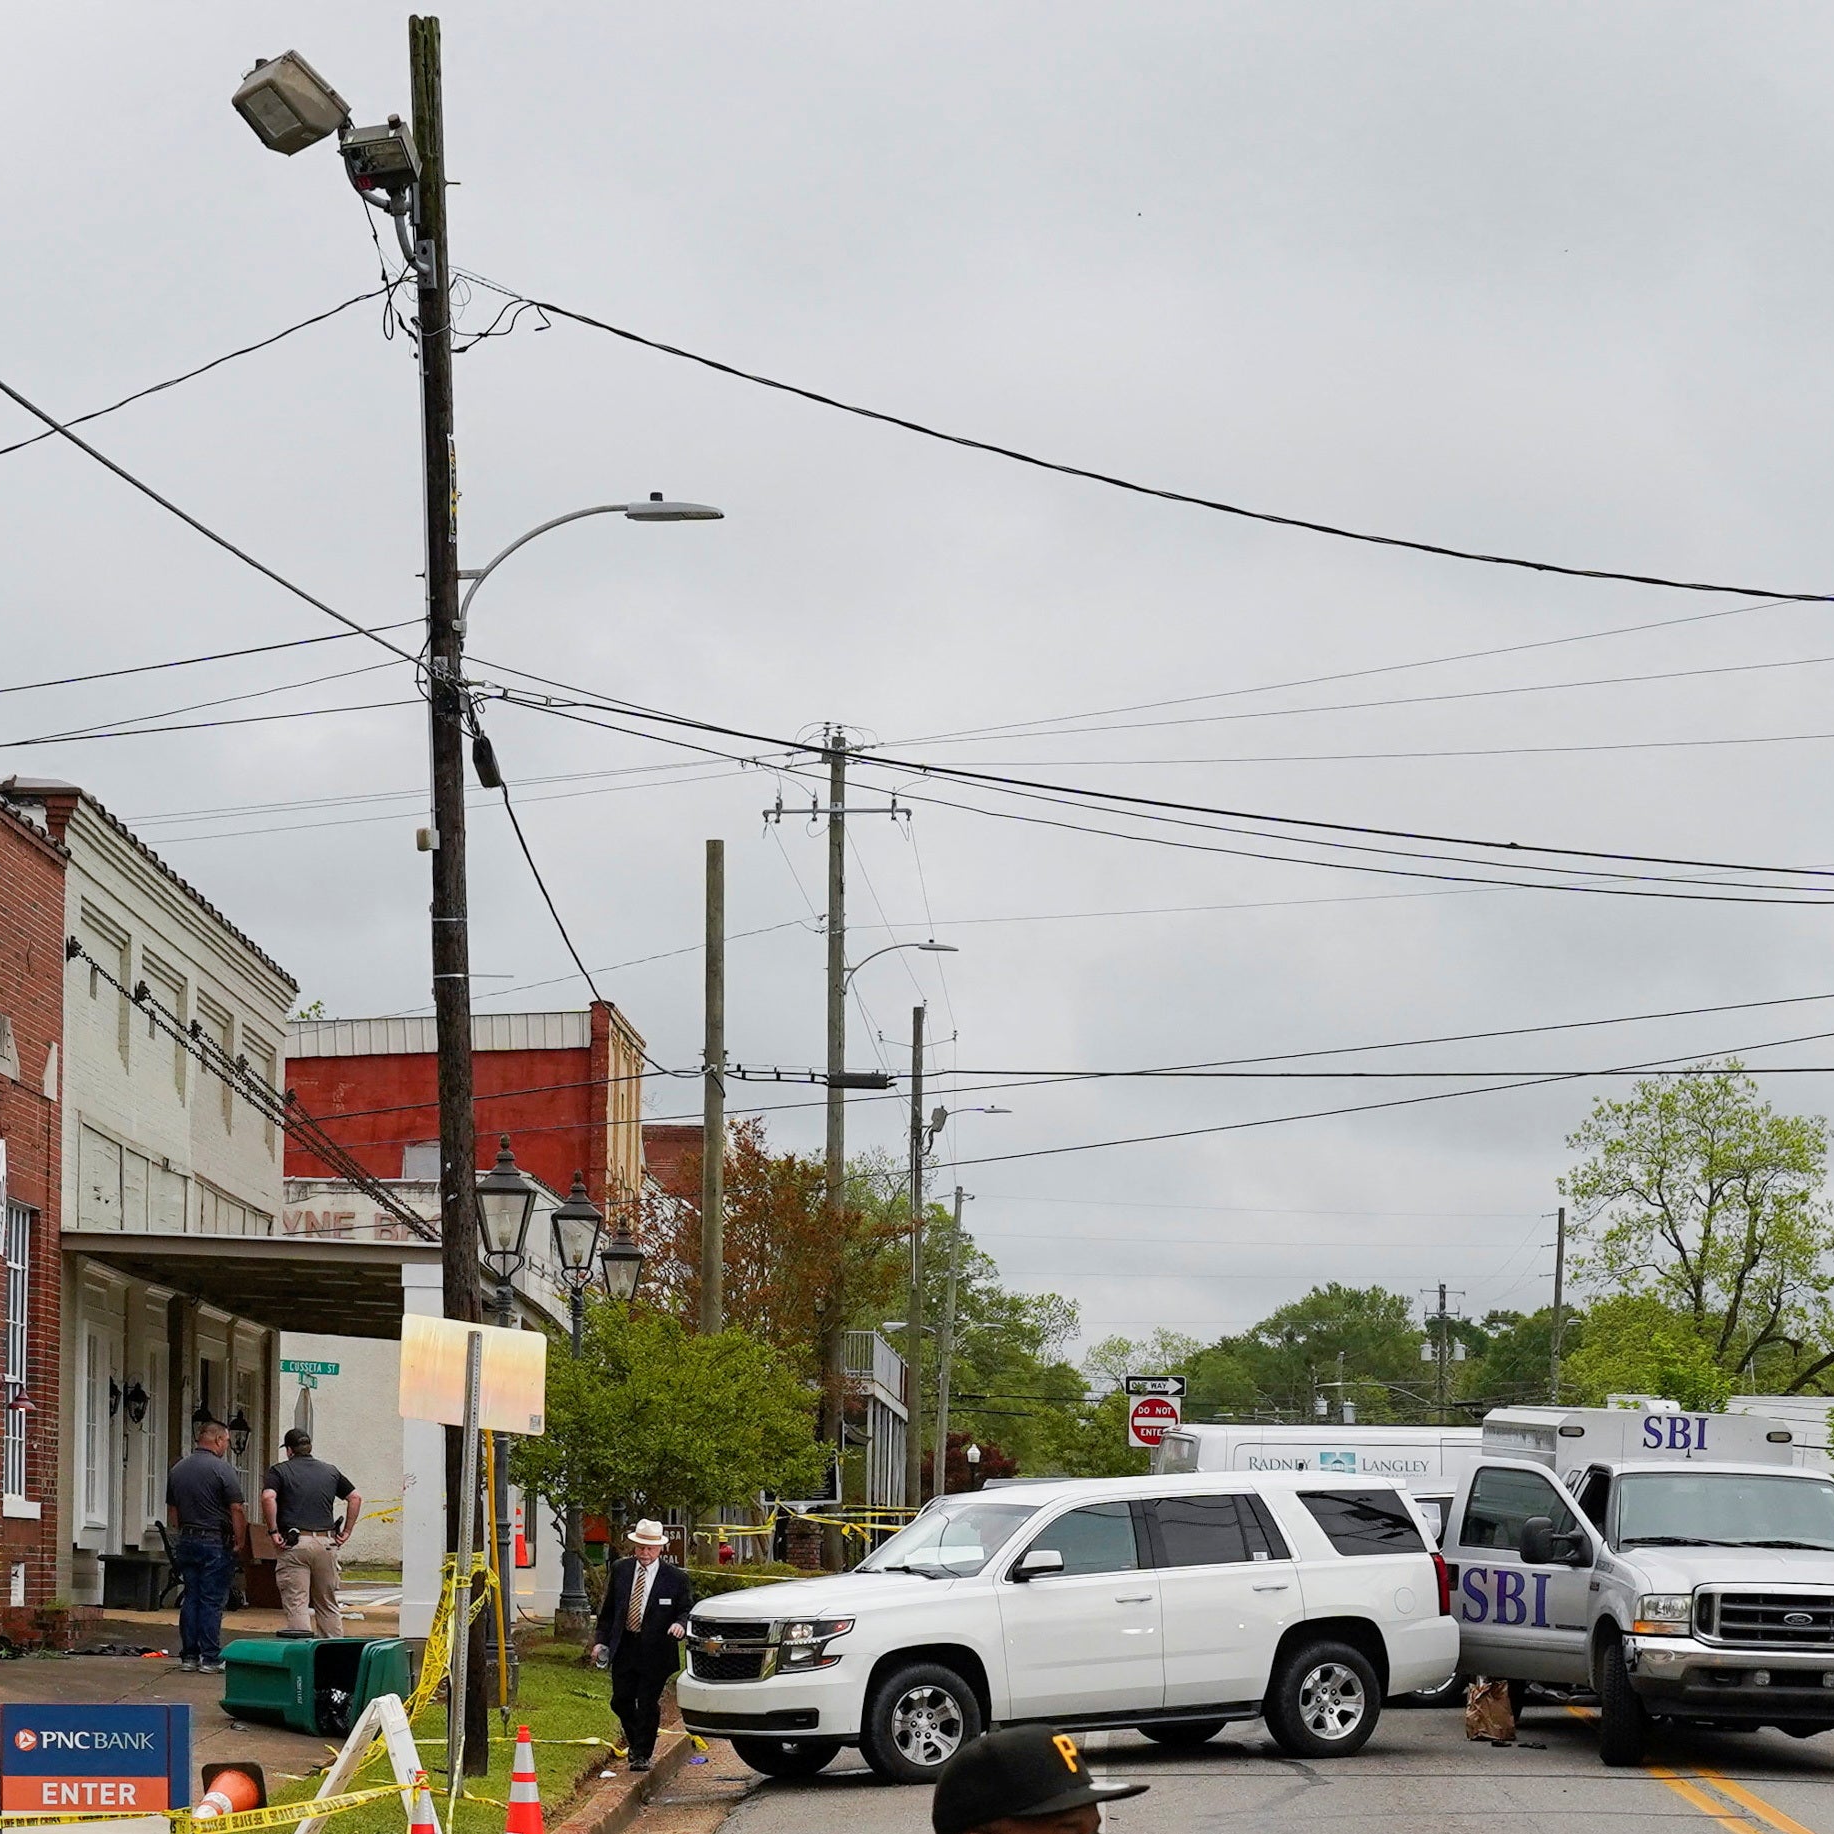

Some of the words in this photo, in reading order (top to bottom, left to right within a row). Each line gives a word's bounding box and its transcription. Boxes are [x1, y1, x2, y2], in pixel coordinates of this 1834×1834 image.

[289, 1361, 322, 1373] CUSSETA
[327, 1364, 336, 1373] ST
[1155, 1407, 1172, 1415] NOT
[1140, 1428, 1163, 1436] ENTE
[1643, 1415, 1709, 1450] SBI
[1363, 1458, 1429, 1472] LANGLEY
[1462, 1567, 1552, 1628] SBI
[1052, 1734, 1077, 1773] P
[42, 1782, 136, 1805] ENTER
